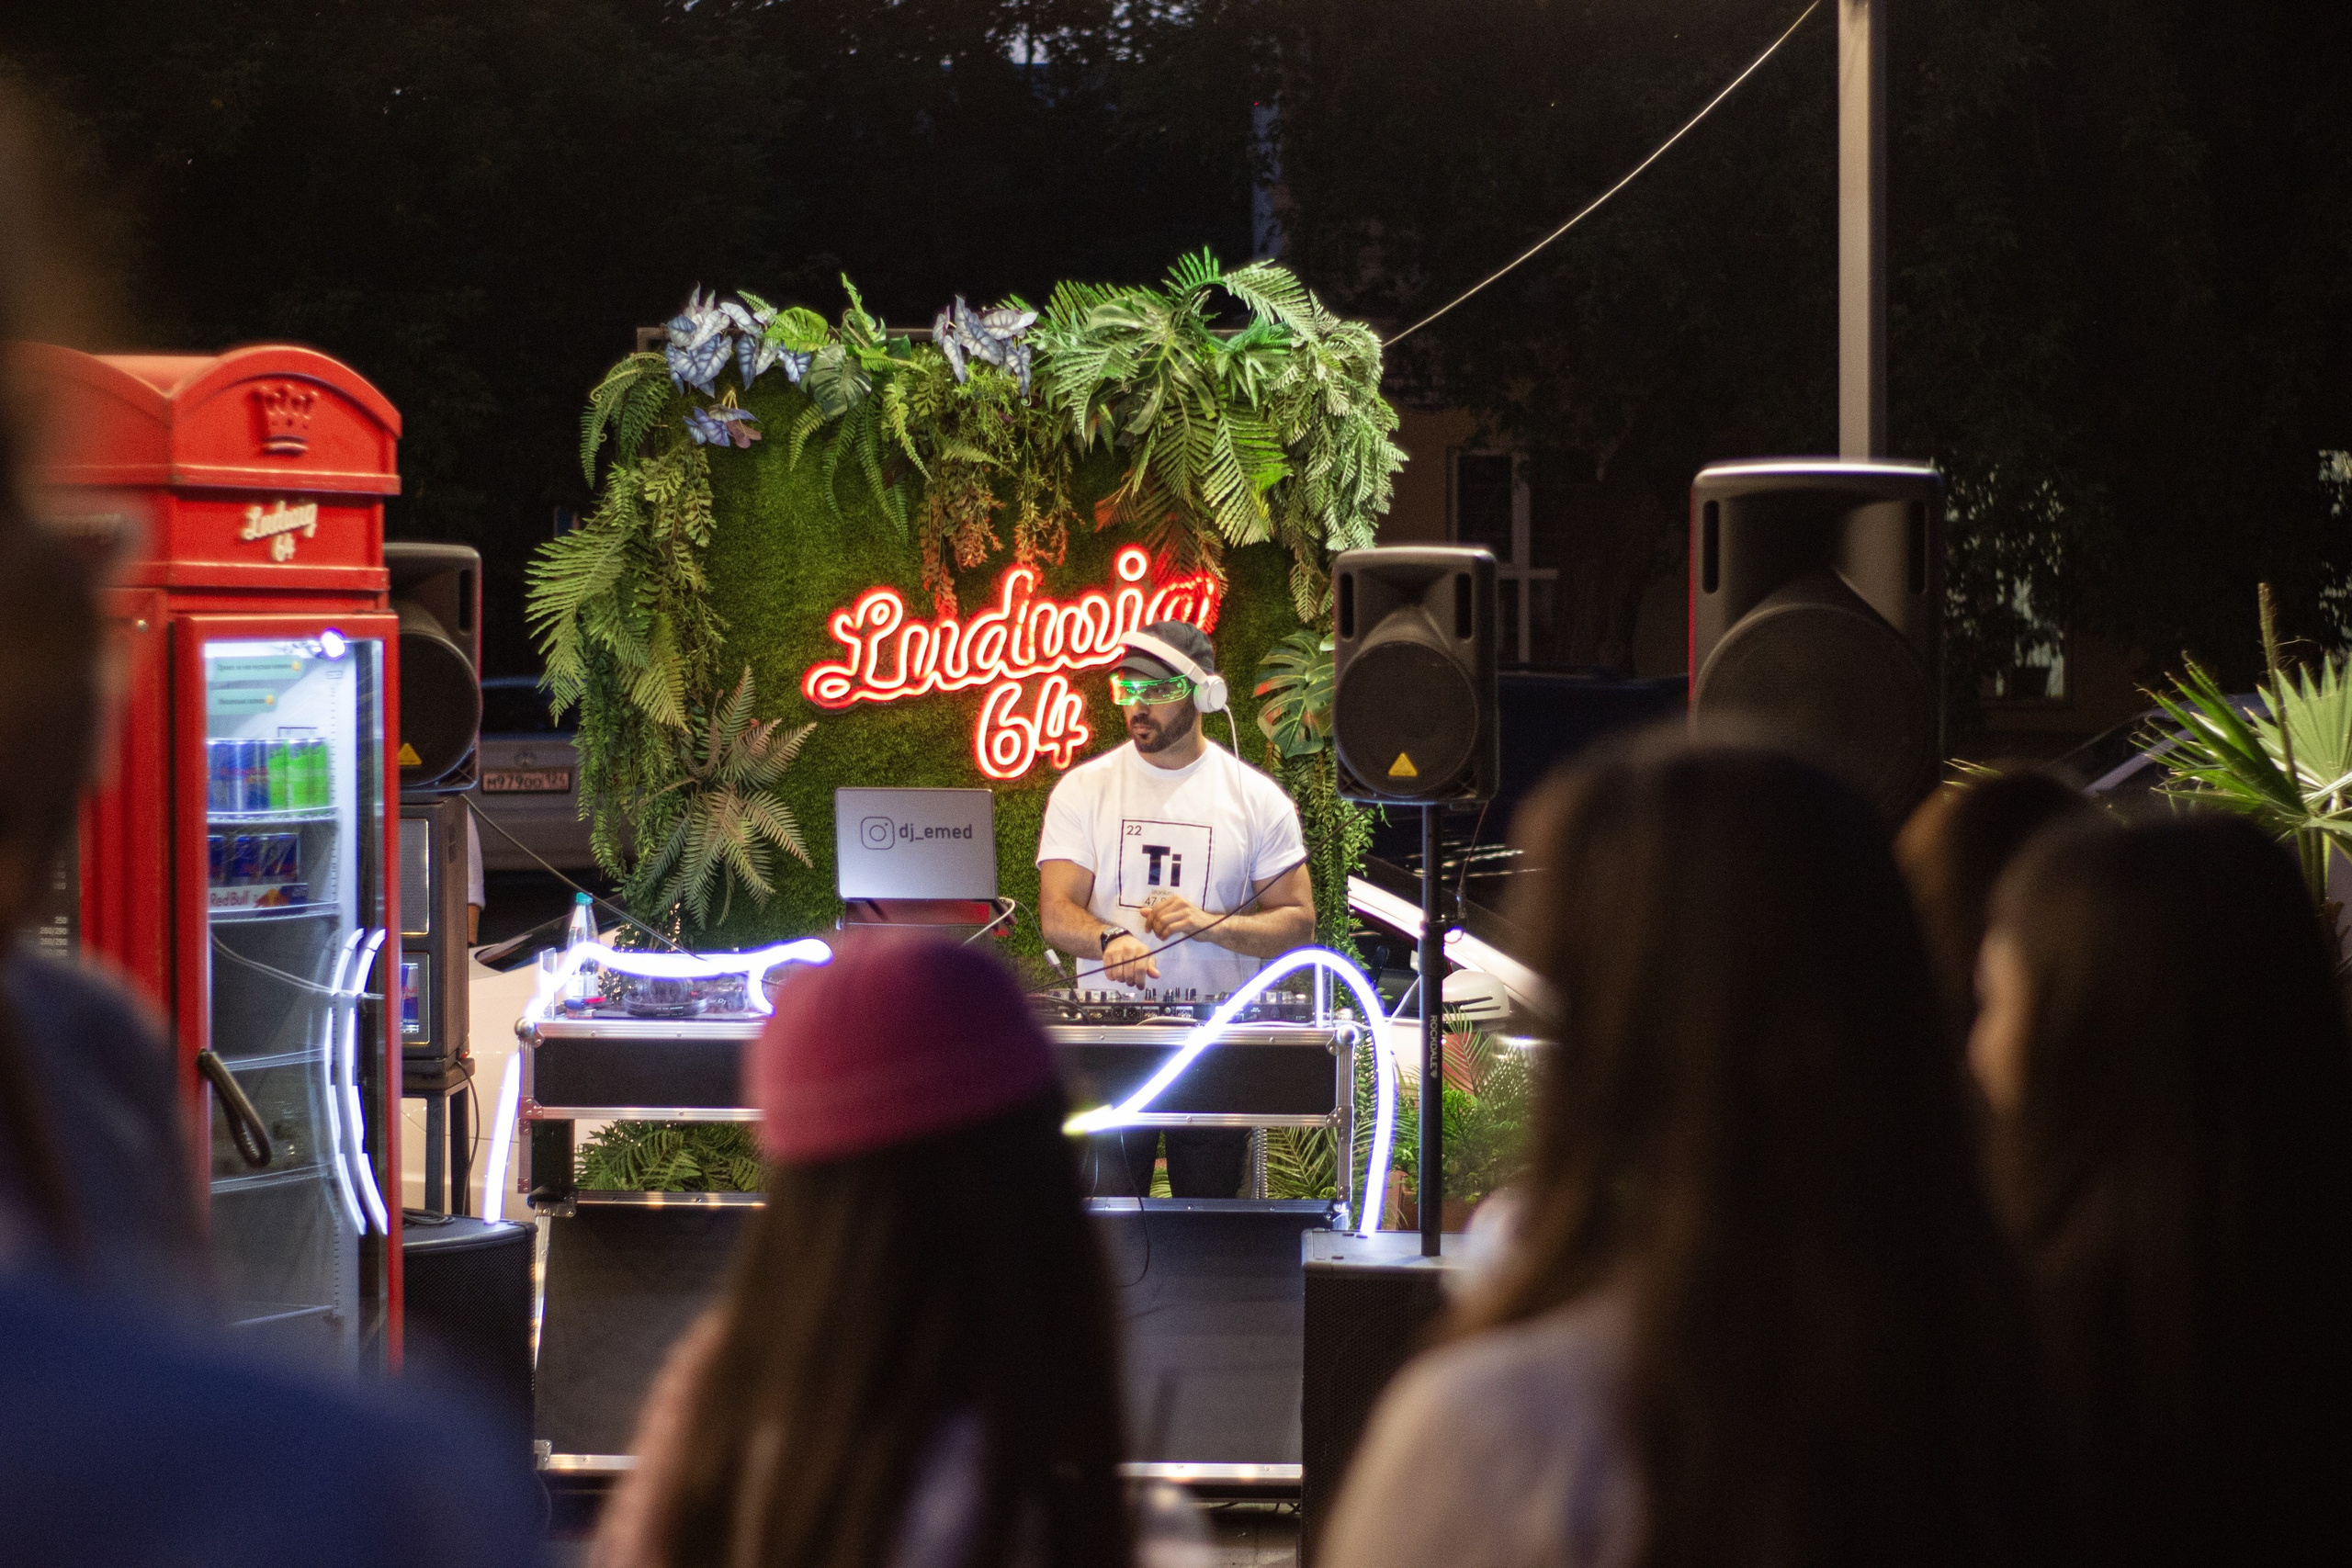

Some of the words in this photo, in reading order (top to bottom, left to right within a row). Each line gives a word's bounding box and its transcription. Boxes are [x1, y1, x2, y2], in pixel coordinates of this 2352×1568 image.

[977, 672, 1090, 780] 64
[899, 823, 973, 842] dj_emed
[1126, 825, 1142, 836] 22
[1142, 844, 1182, 887] Ti
[1430, 1014, 1438, 1069] ROCKDALE
